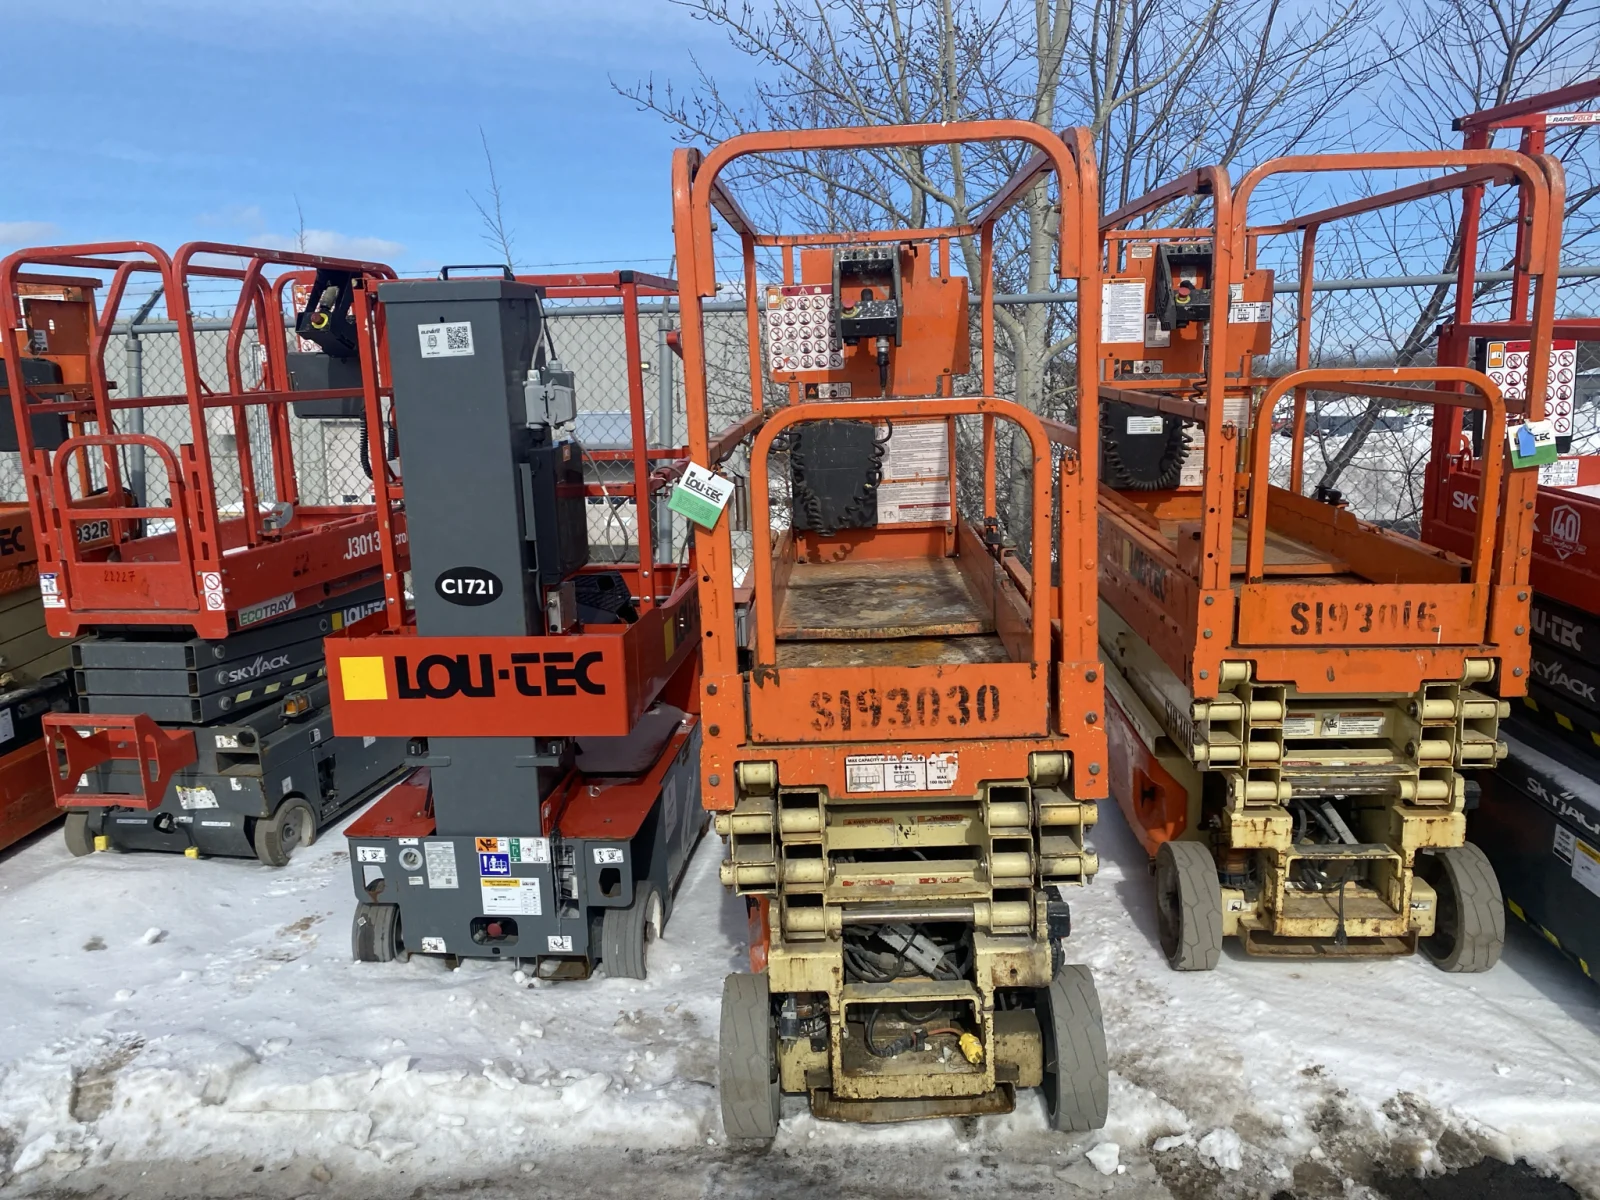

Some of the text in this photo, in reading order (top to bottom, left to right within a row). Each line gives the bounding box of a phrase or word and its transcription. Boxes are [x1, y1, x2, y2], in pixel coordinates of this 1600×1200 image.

[1554, 510, 1577, 542] 40
[343, 531, 381, 560] J3013
[441, 578, 494, 595] C1721
[240, 593, 293, 626] ECOTRAY
[229, 655, 291, 683] SKYJACK
[1531, 659, 1596, 703] KYJACK
